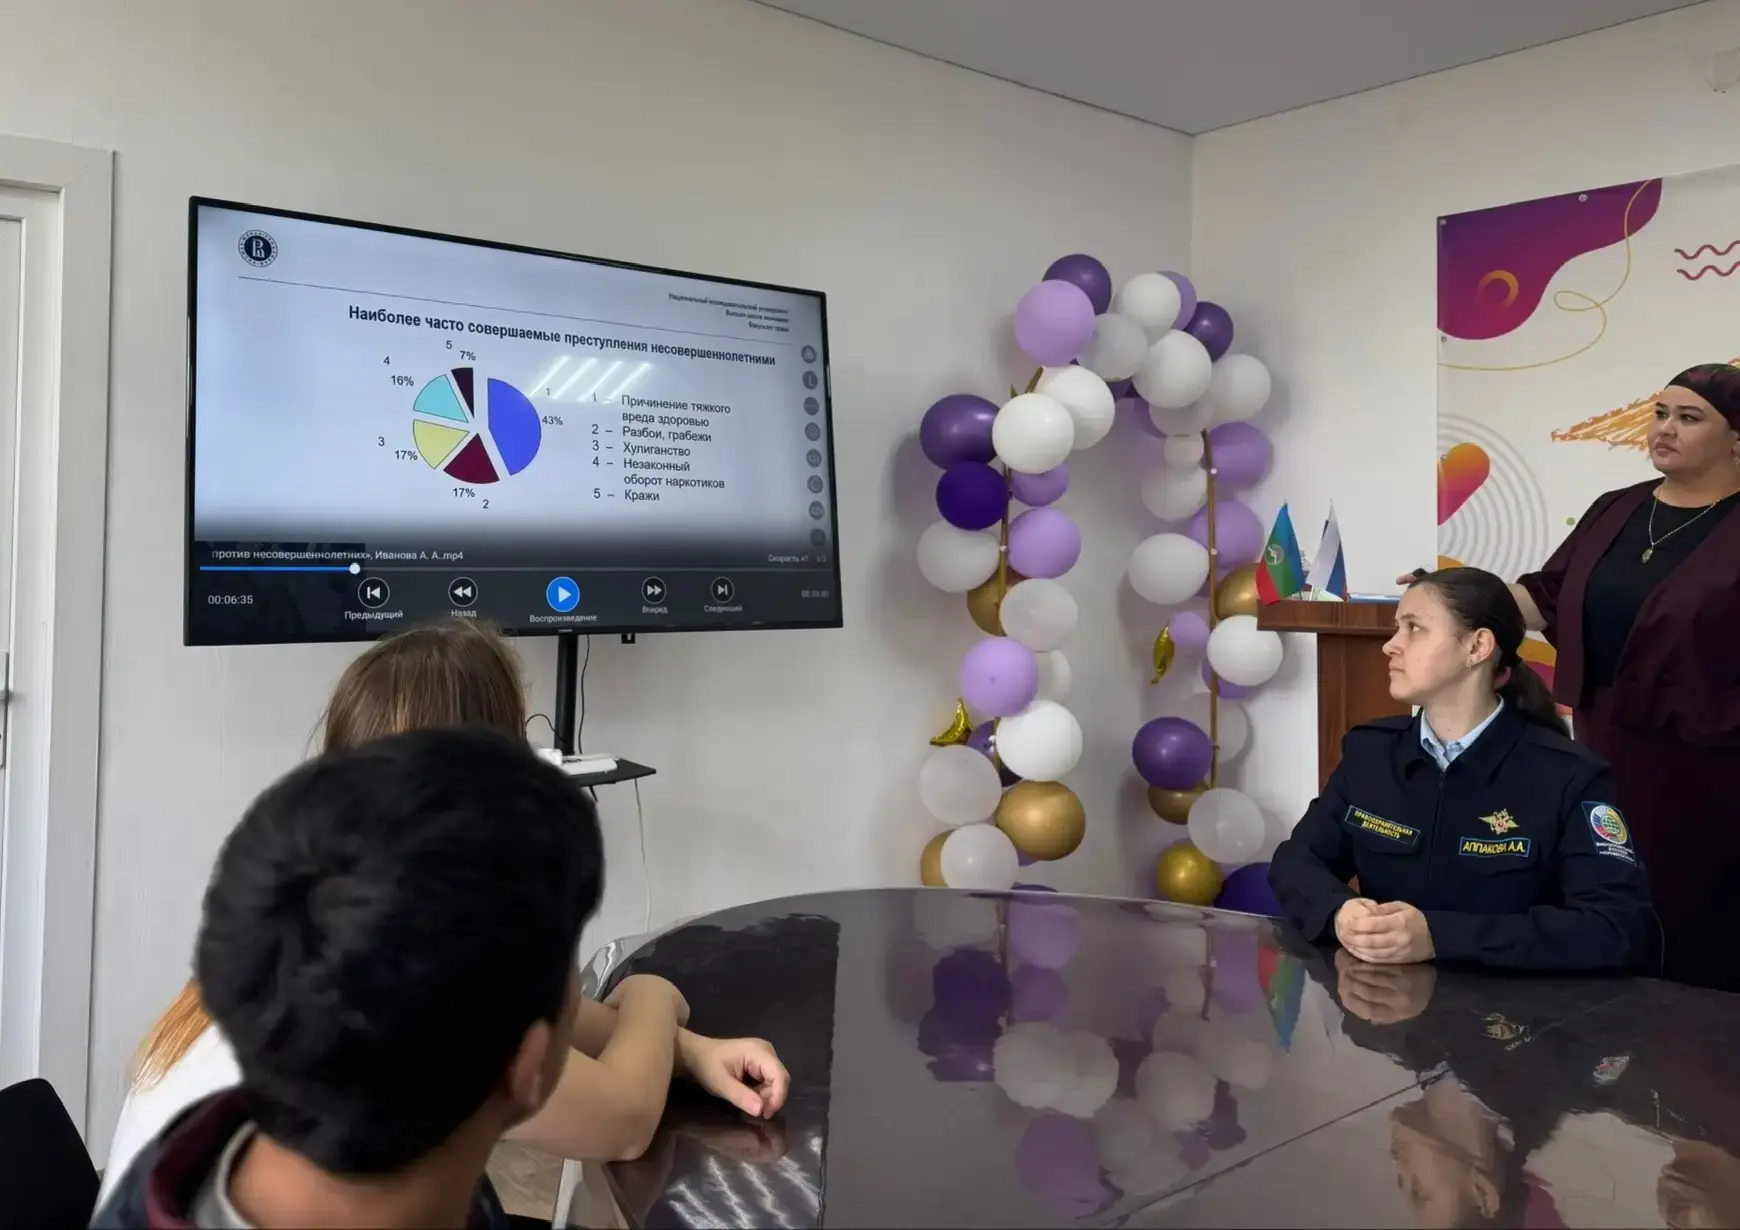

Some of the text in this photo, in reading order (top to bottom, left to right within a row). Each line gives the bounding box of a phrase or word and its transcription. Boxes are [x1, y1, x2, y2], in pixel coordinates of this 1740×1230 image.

[348, 305, 776, 366] Наиболее часто совершаемые преступления несовершеннолетними
[445, 340, 453, 350] 5
[383, 356, 390, 365] 4
[459, 350, 476, 361] 7%
[390, 375, 415, 387] 16%
[621, 394, 689, 411] Причинение
[690, 402, 731, 414] тяжкого
[541, 415, 564, 426] 43%
[622, 411, 710, 428] вреда здоровью
[591, 423, 599, 435] 2
[622, 425, 665, 440] Разбои,
[668, 429, 712, 442] грабежи
[378, 436, 385, 447] 3
[592, 439, 600, 451] 3
[623, 441, 691, 457] Хулиганство
[394, 450, 418, 461] 17%
[592, 456, 600, 467] 4
[623, 457, 690, 472] Незаконный
[623, 473, 725, 489] оборот наркотиков
[452, 487, 475, 498] 17%
[593, 488, 601, 499] 5
[624, 489, 660, 502] Кражи
[482, 499, 489, 509] 2
[211, 550, 251, 560] против
[253, 550, 373, 561] несовершеннолетних»,
[375, 550, 418, 560] Иванова
[207, 594, 254, 605] 00:06:35
[450, 609, 477, 618] Назад
[703, 604, 743, 614] Следующий
[344, 610, 404, 621] Предыдущий
[529, 614, 598, 624] Воспроизведение
